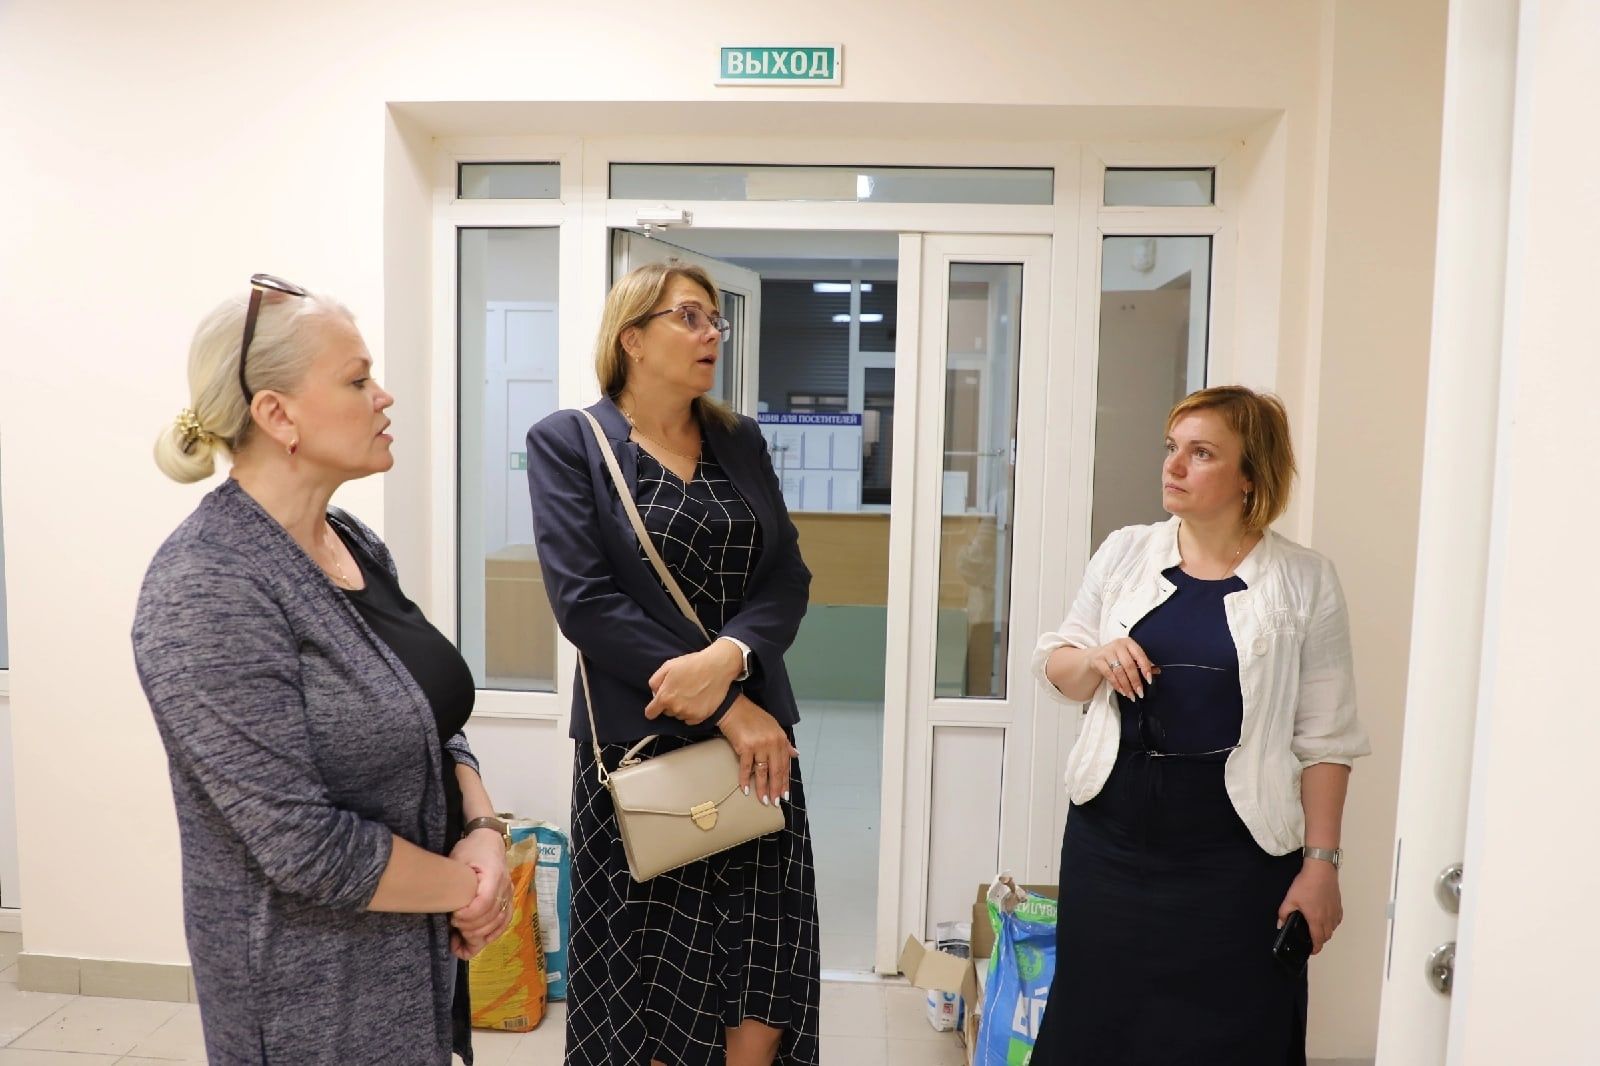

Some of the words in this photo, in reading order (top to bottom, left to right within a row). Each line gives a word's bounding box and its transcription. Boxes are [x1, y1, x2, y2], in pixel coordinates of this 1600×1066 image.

[727, 50, 829, 77] ВЫХОД
[780, 415, 797, 423] ДЛЯ
[799, 414, 857, 424] ПОСЕТИТЕЛЕЙ
